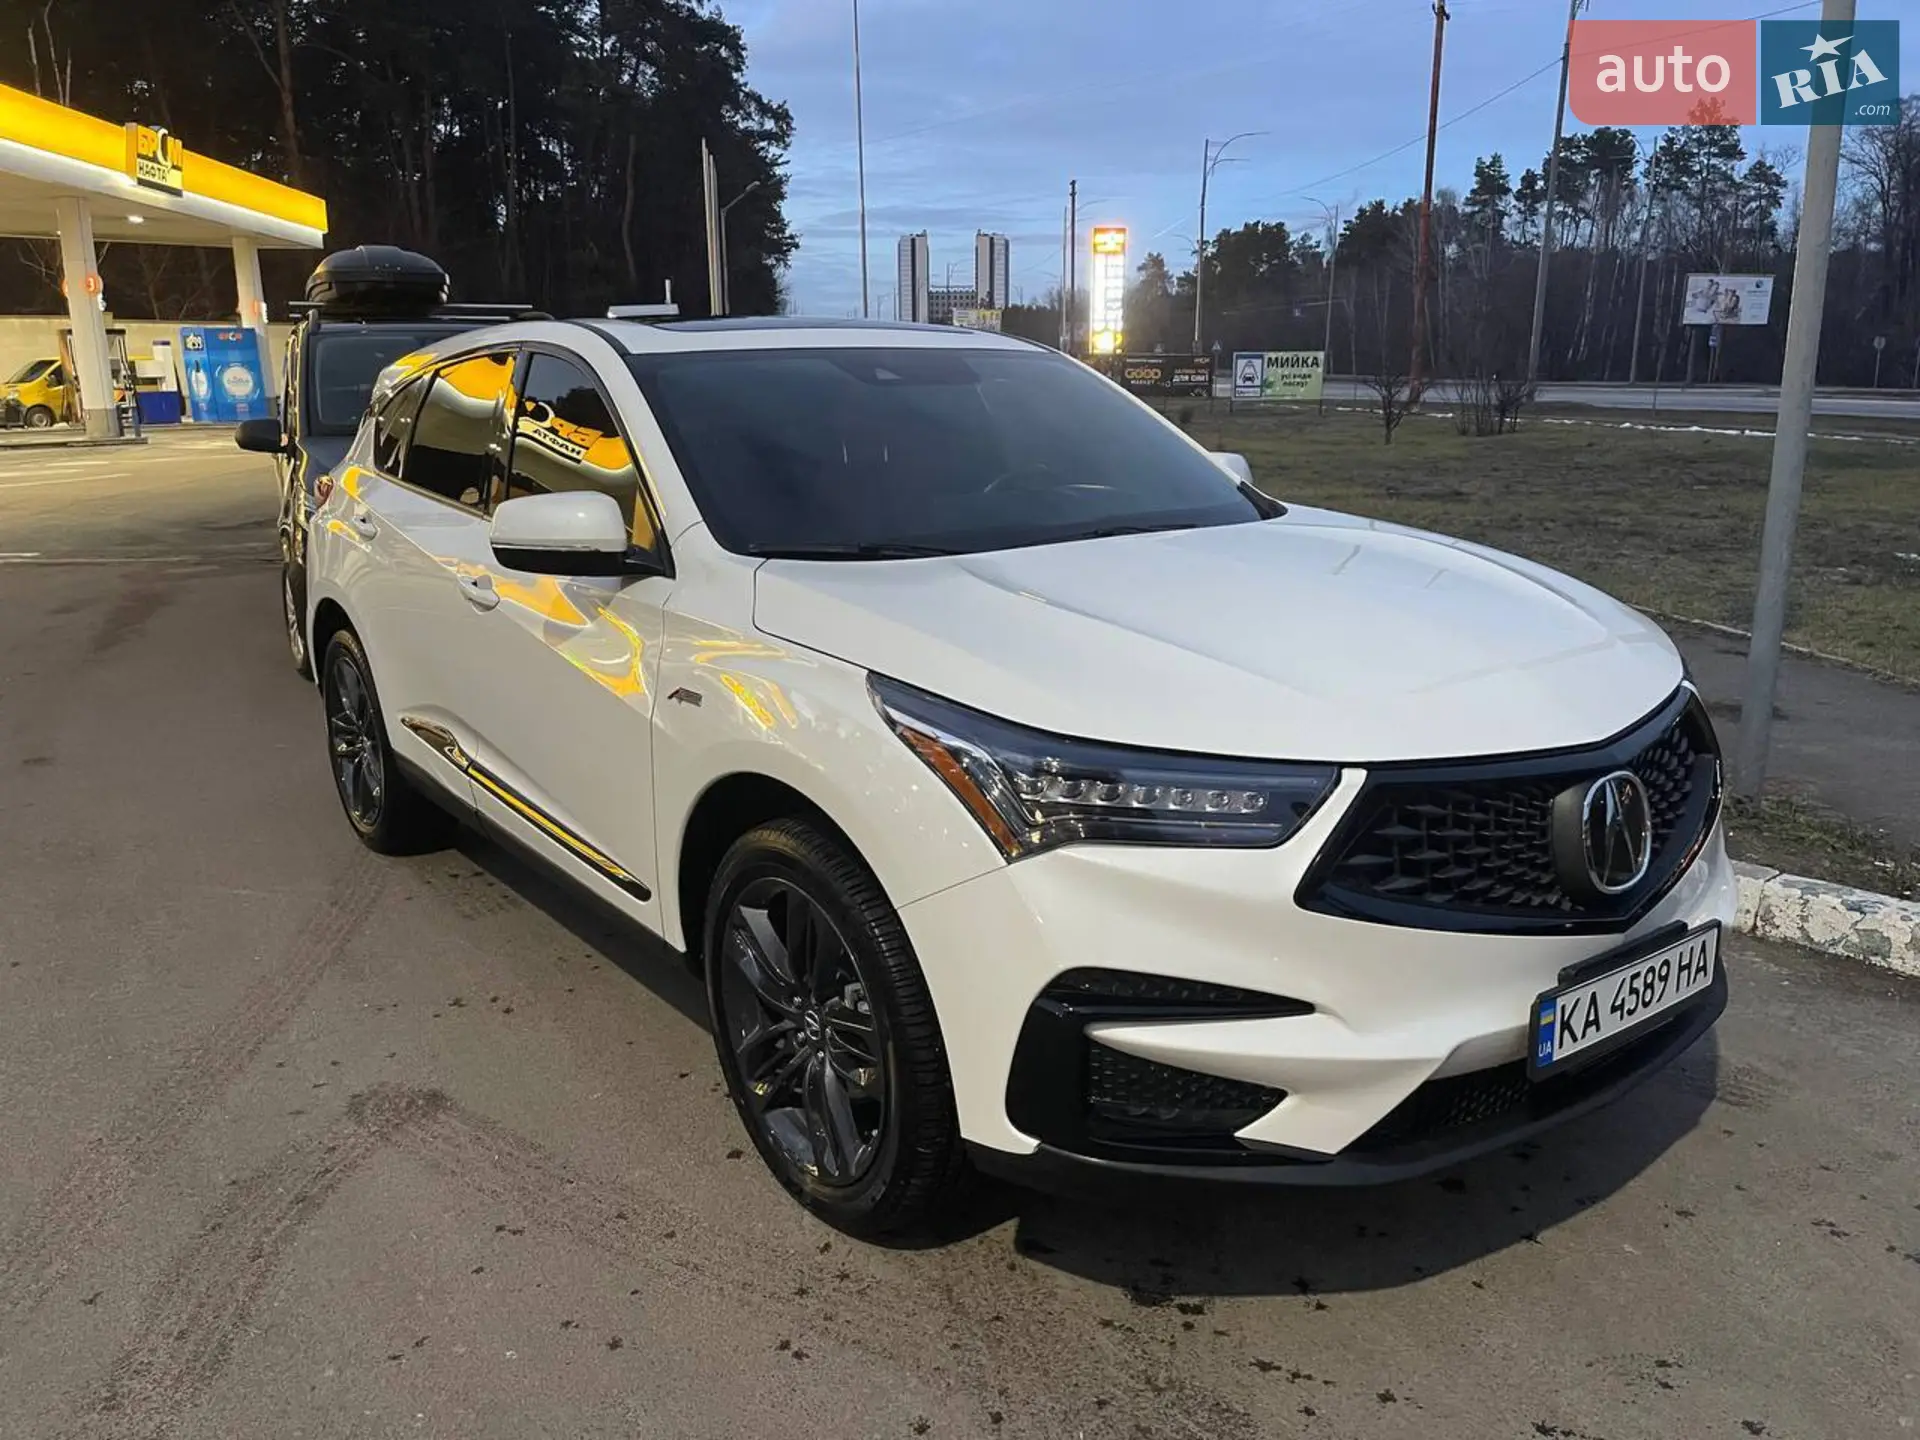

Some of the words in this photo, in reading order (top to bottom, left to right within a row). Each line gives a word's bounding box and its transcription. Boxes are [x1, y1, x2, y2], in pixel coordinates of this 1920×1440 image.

[1267, 354, 1320, 368] МИЙКА
[1125, 368, 1162, 379] GOOD
[1558, 991, 1601, 1049] KA
[1610, 958, 1671, 1022] 4589
[1675, 940, 1708, 993] HA
[1538, 1040, 1552, 1057] UA
